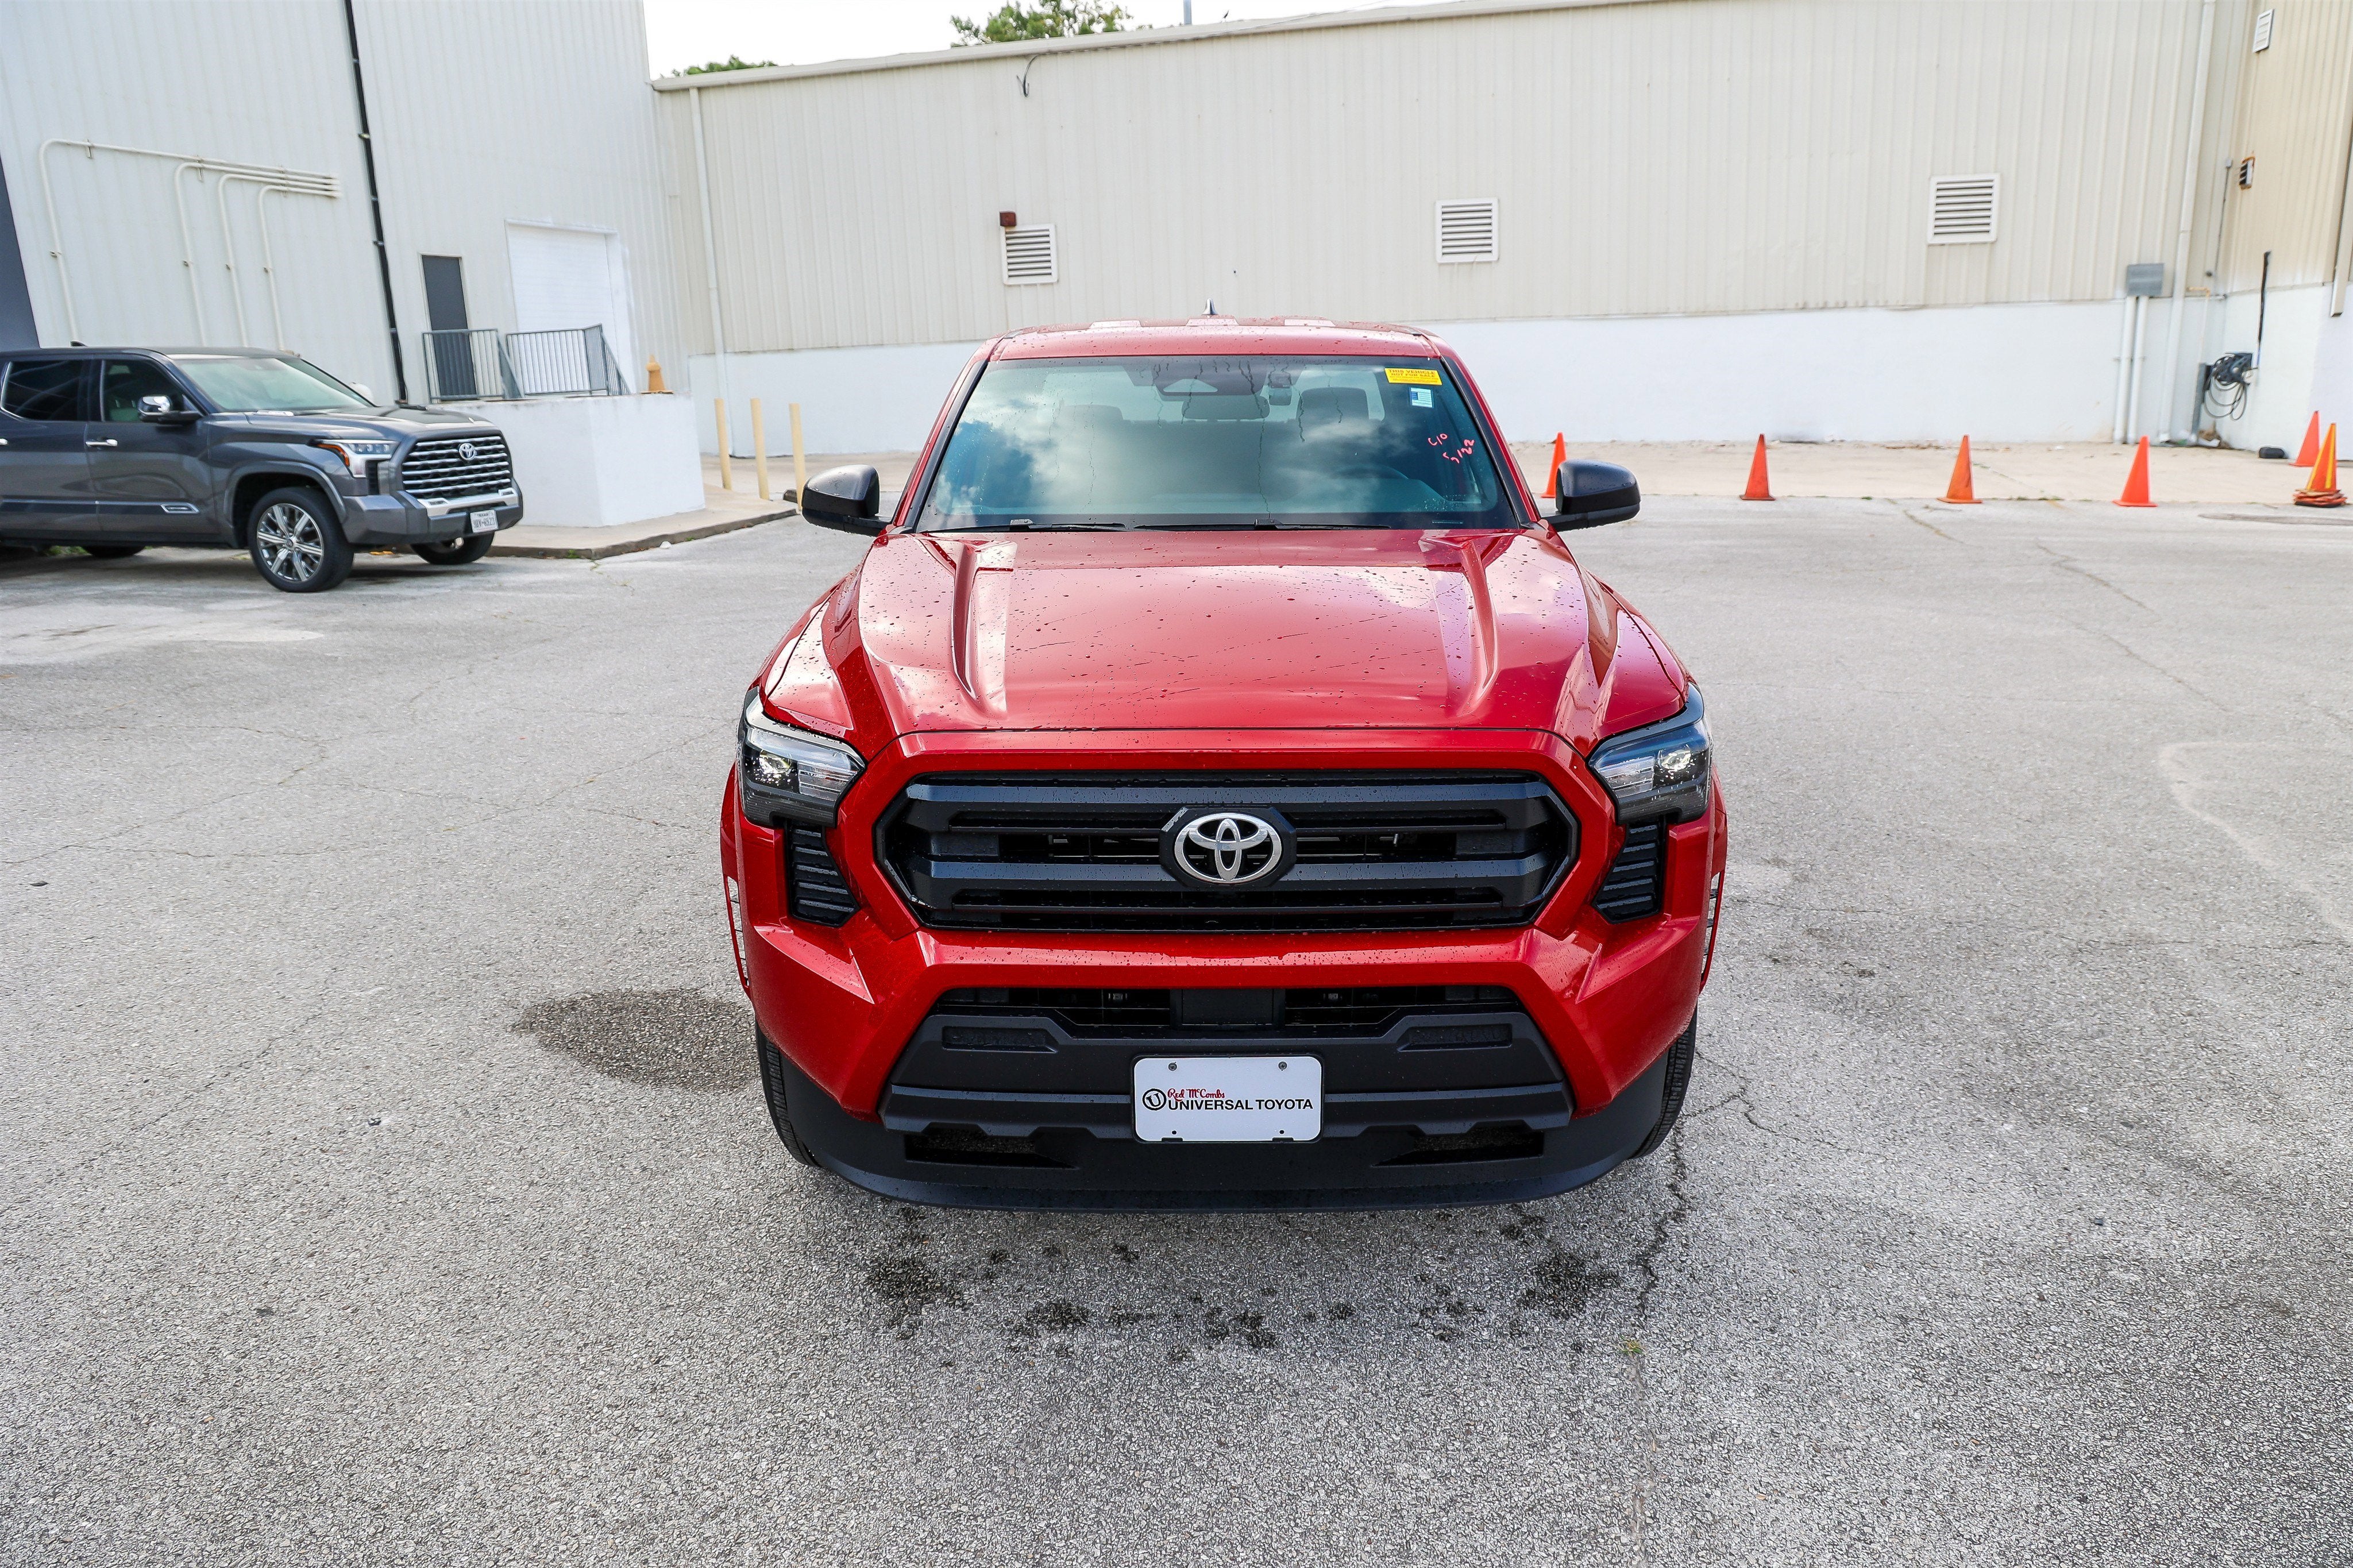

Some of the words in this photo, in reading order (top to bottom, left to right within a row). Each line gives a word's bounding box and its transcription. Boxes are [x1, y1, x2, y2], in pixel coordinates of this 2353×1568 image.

[1167, 1088, 1185, 1102] Red
[1186, 1088, 1225, 1098] McCombs
[1168, 1099, 1253, 1110] UNIVERSAL
[1255, 1099, 1313, 1110] TOYOTA
